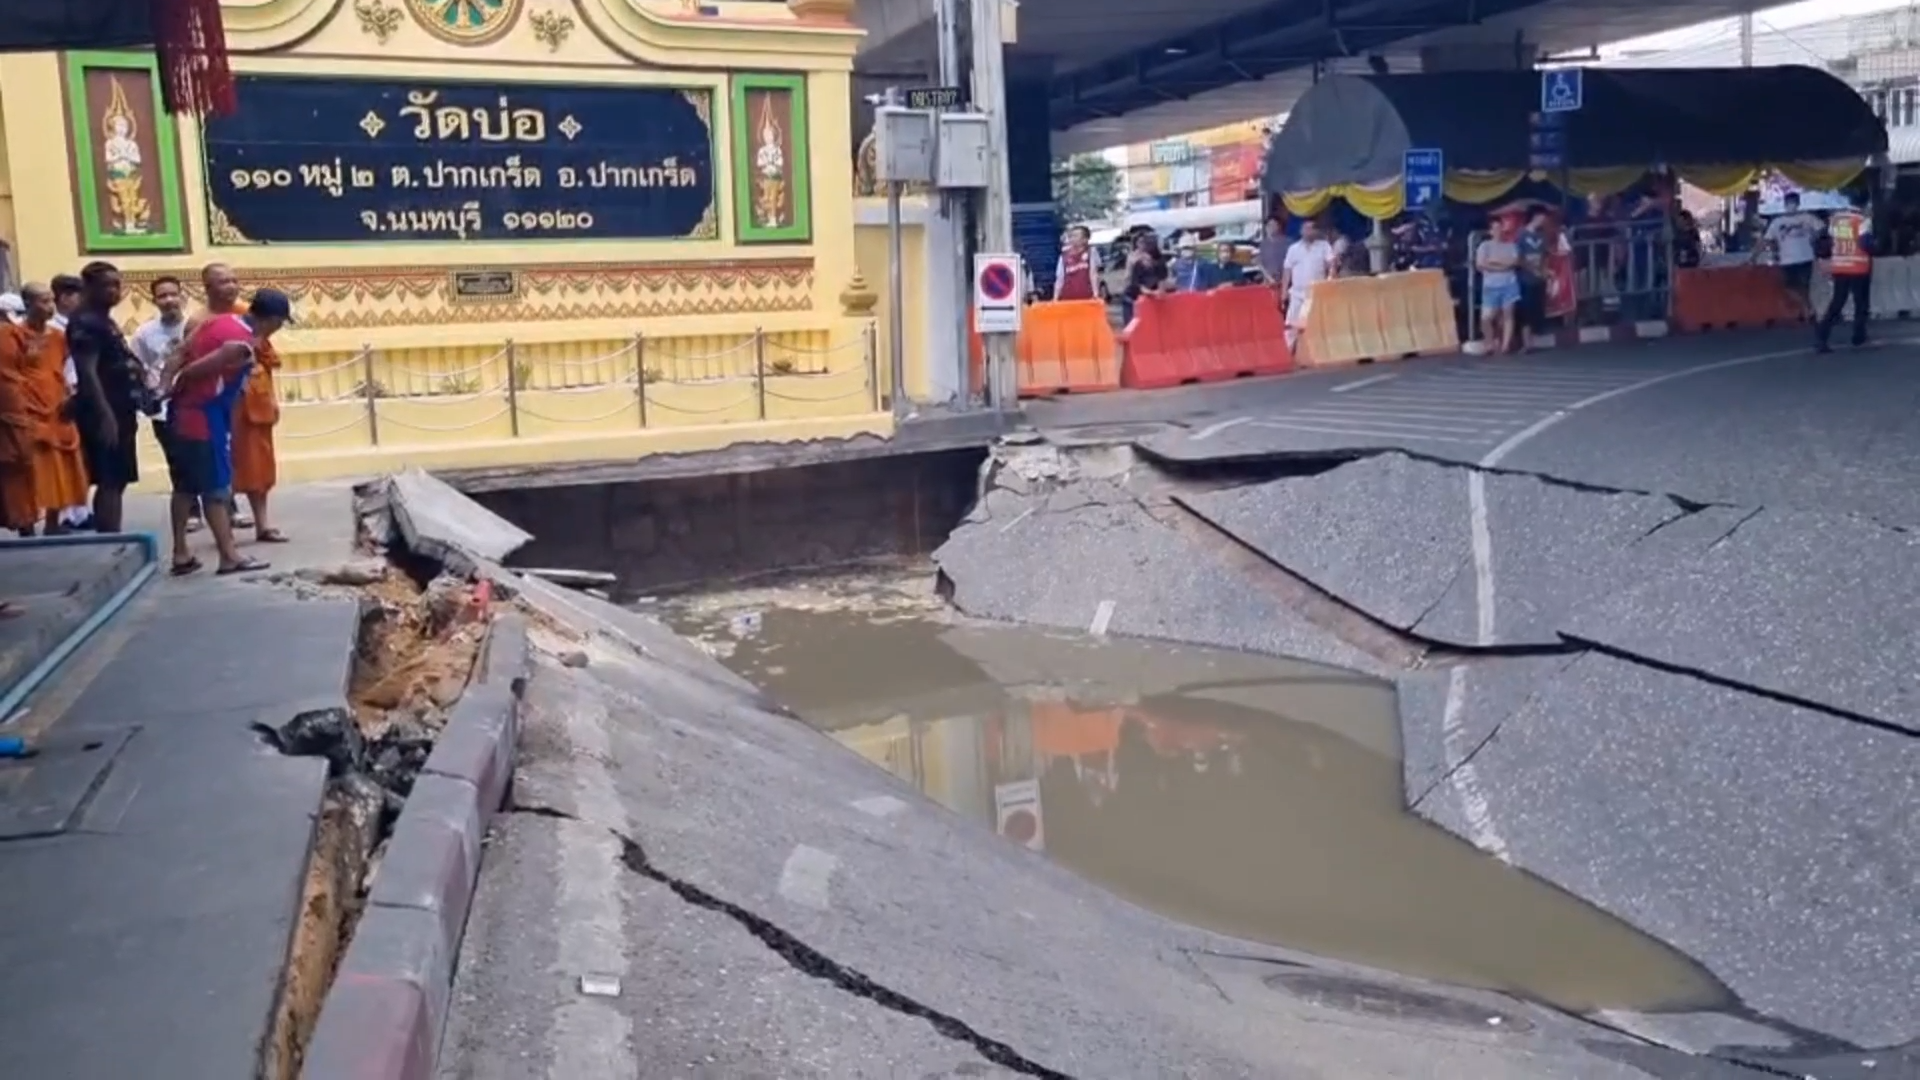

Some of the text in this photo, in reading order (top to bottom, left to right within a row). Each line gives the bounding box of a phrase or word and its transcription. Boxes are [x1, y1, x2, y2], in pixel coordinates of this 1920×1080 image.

[399, 90, 546, 141] วัดบ่อ
[230, 155, 697, 197] ๑๑๐ หมู่ ๒ ต.ปากเกร็ด อ.ปากเกร็ด
[360, 201, 594, 239] จ.นนทบุรี ๑๑๑๒๐
